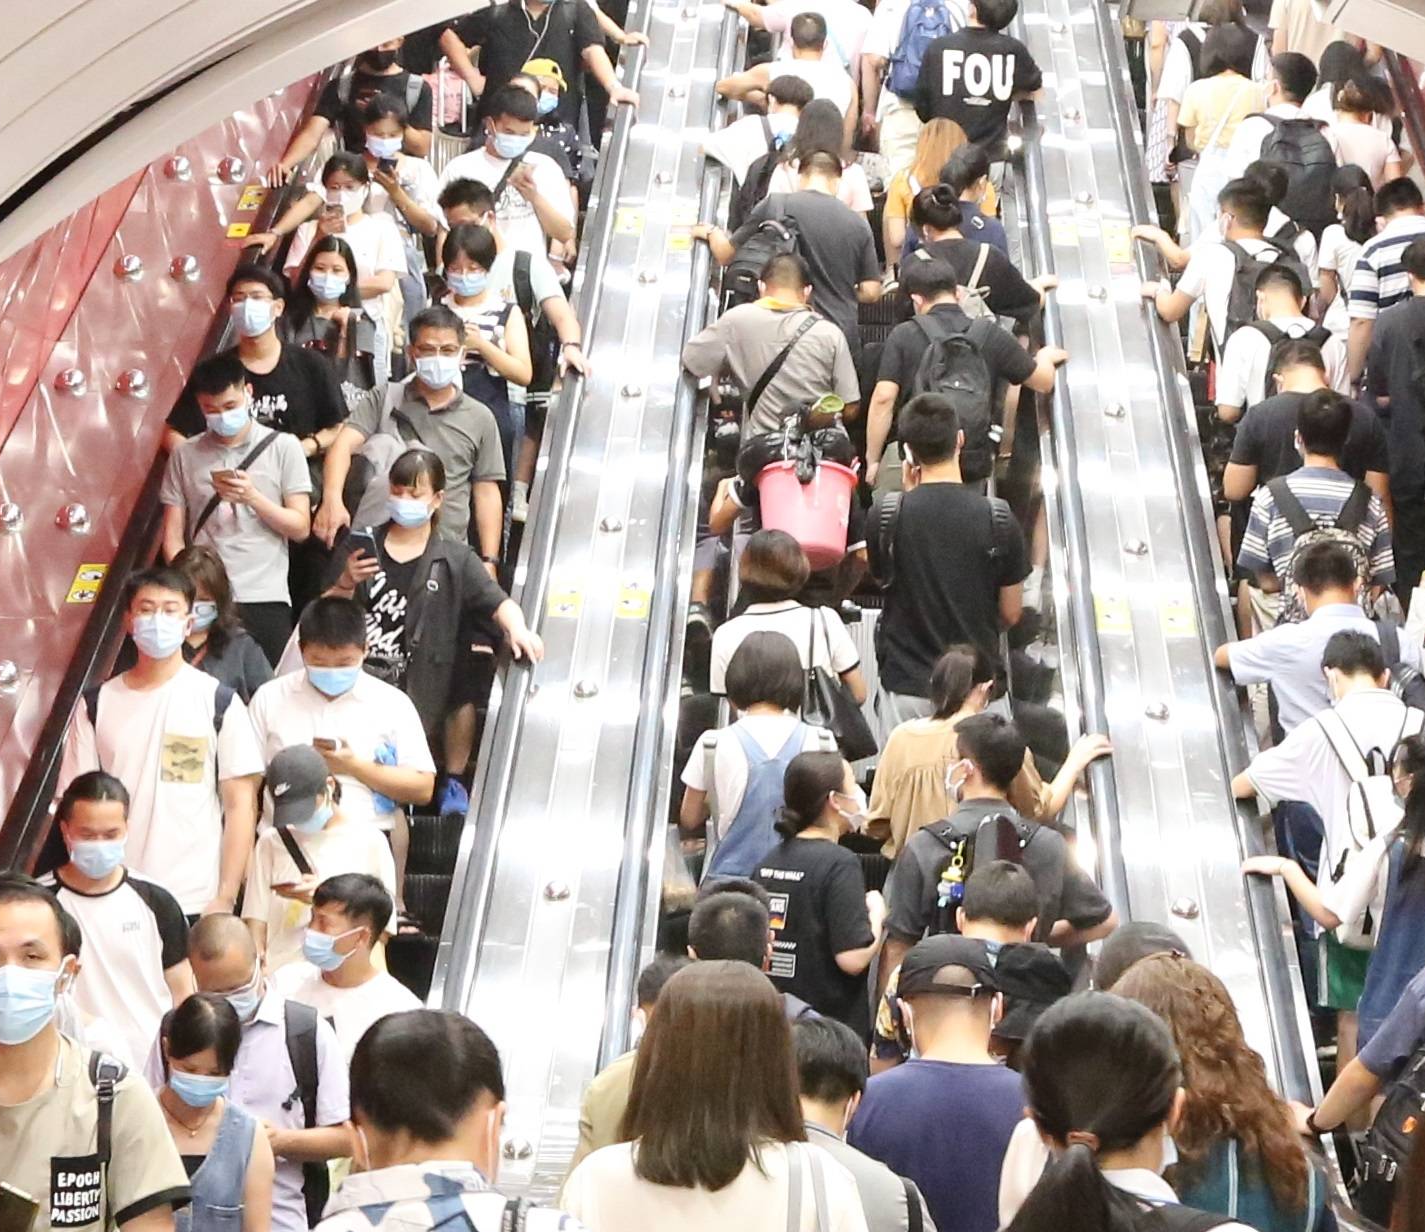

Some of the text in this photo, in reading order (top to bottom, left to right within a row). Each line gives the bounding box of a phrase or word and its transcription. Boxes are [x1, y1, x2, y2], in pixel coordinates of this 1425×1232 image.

[942, 49, 1016, 102] FOU
[57, 1171, 100, 1188] EPOCH
[53, 1189, 101, 1206] LIBERTY
[50, 1203, 99, 1223] PASSION
